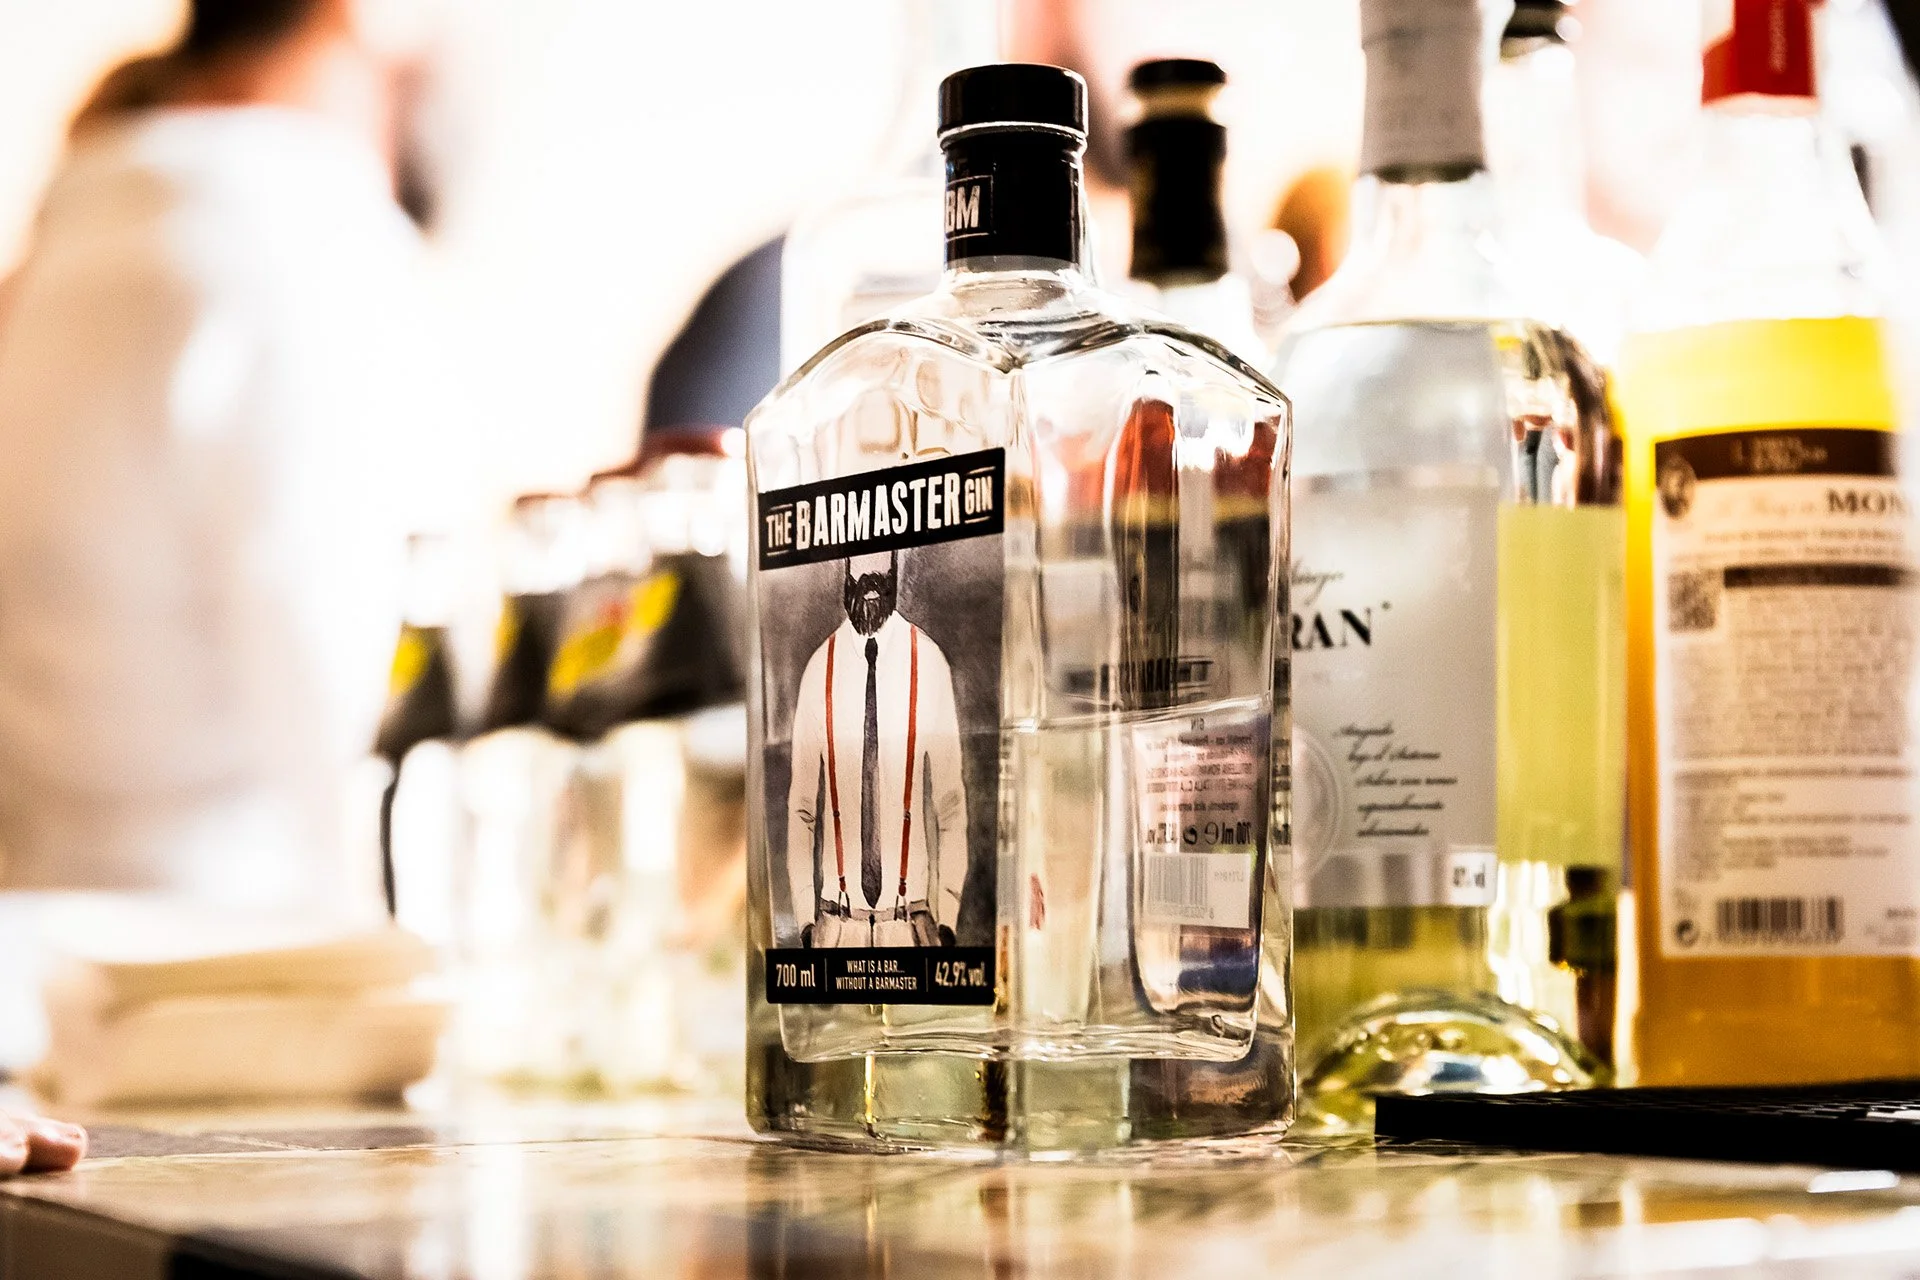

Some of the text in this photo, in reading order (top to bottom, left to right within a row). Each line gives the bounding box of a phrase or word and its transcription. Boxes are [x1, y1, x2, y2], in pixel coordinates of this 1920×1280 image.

[945, 185, 980, 233] BM
[766, 472, 993, 551] THE BARMASTER GIN
[776, 963, 816, 987] 700 ml
[846, 960, 866, 974] WHAT
[867, 960, 876, 974] IS
[877, 960, 883, 974] A
[835, 977, 918, 991] WITHOUT A BARMASTER
